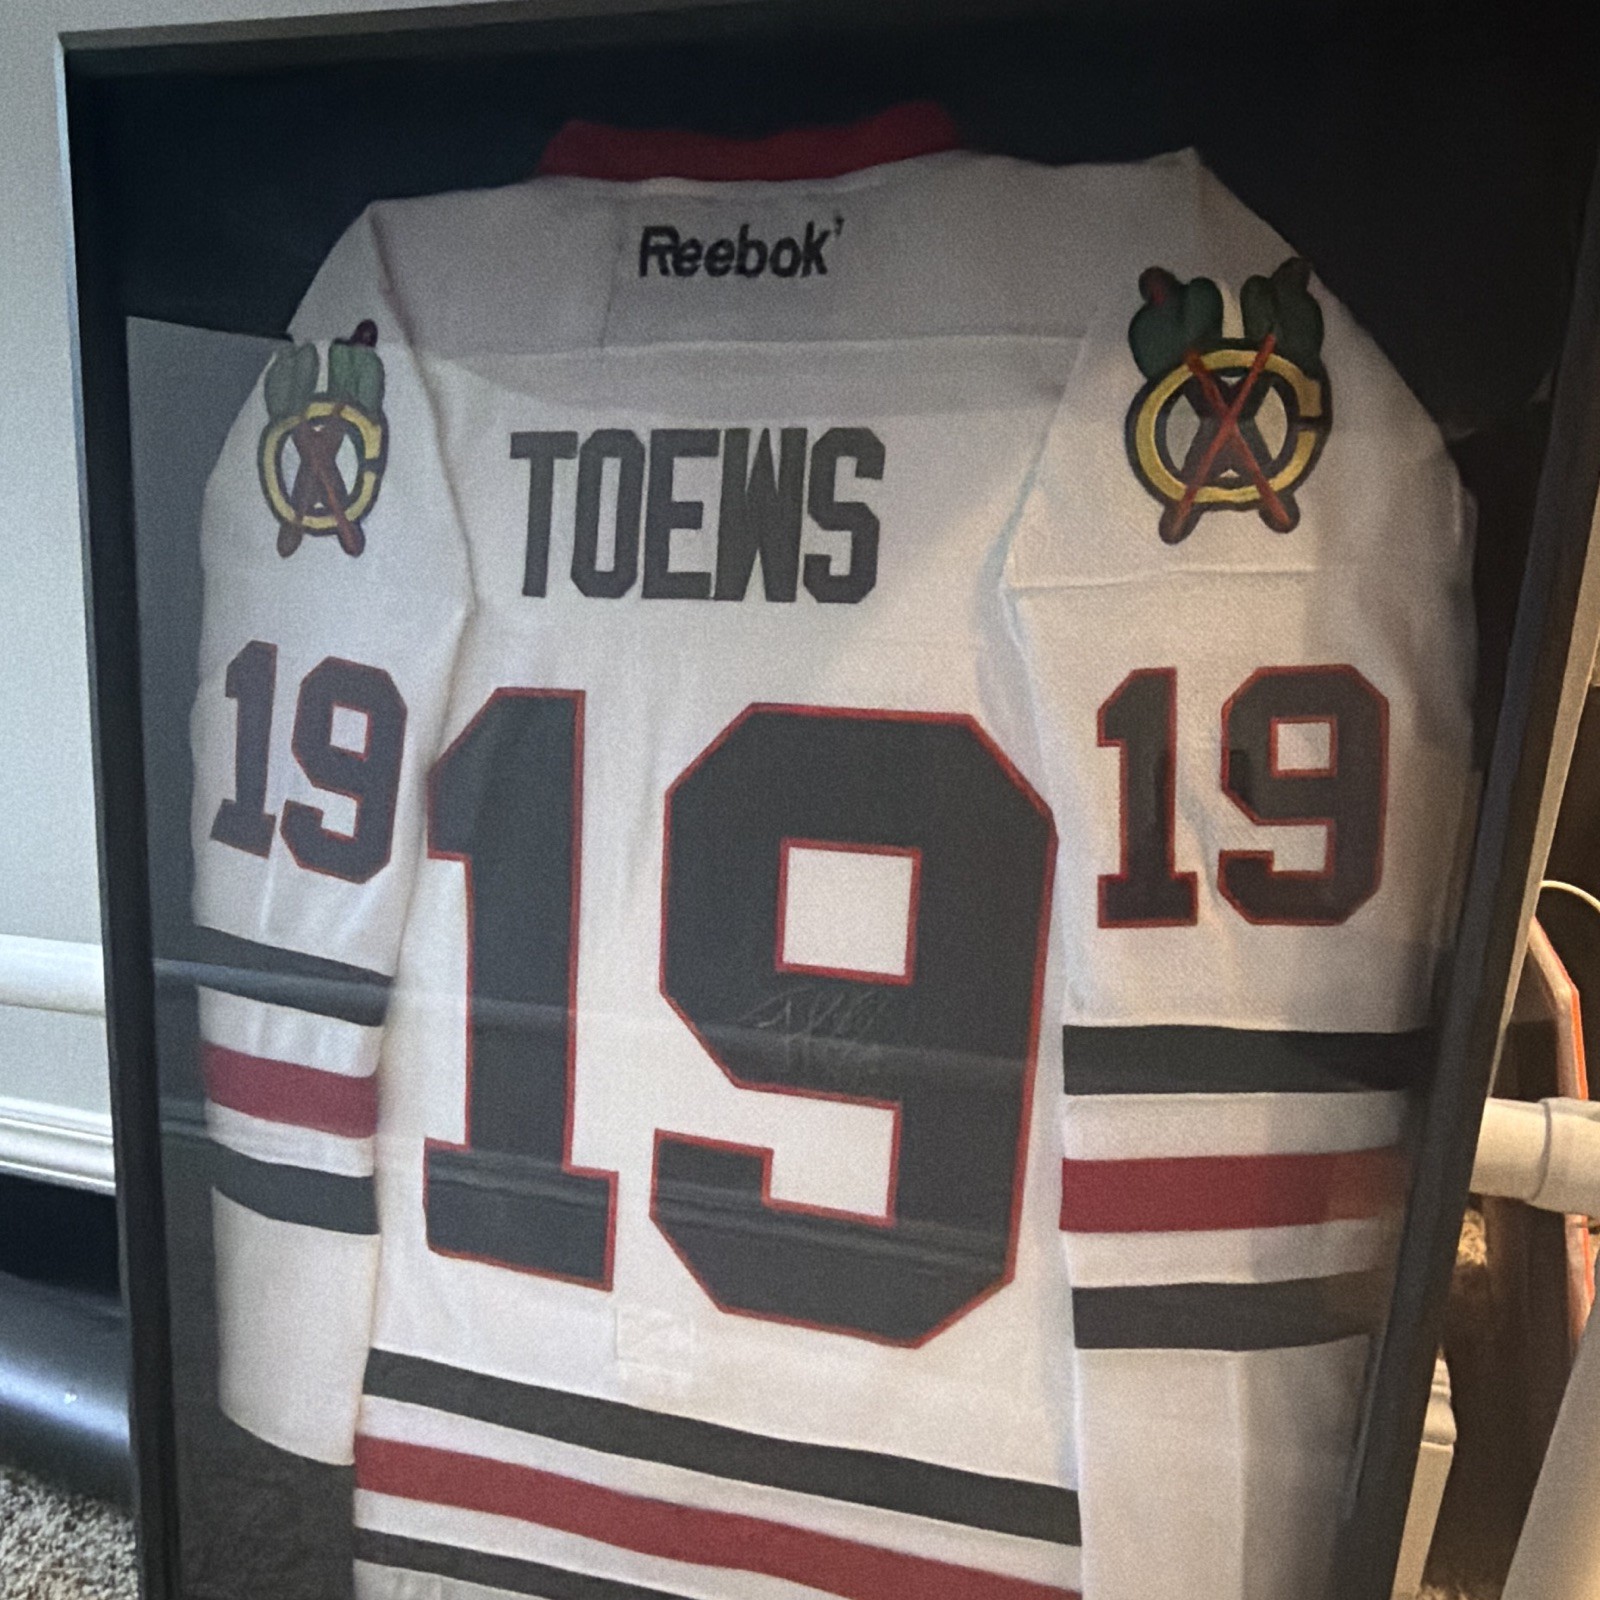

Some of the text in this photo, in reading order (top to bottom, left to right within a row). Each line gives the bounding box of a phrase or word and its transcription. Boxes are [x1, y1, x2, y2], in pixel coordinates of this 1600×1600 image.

[639, 221, 831, 278] Reebok
[510, 427, 886, 604] TOEWS
[210, 639, 408, 884] 19
[1097, 663, 1390, 930] 19
[423, 686, 1060, 1349] 19
